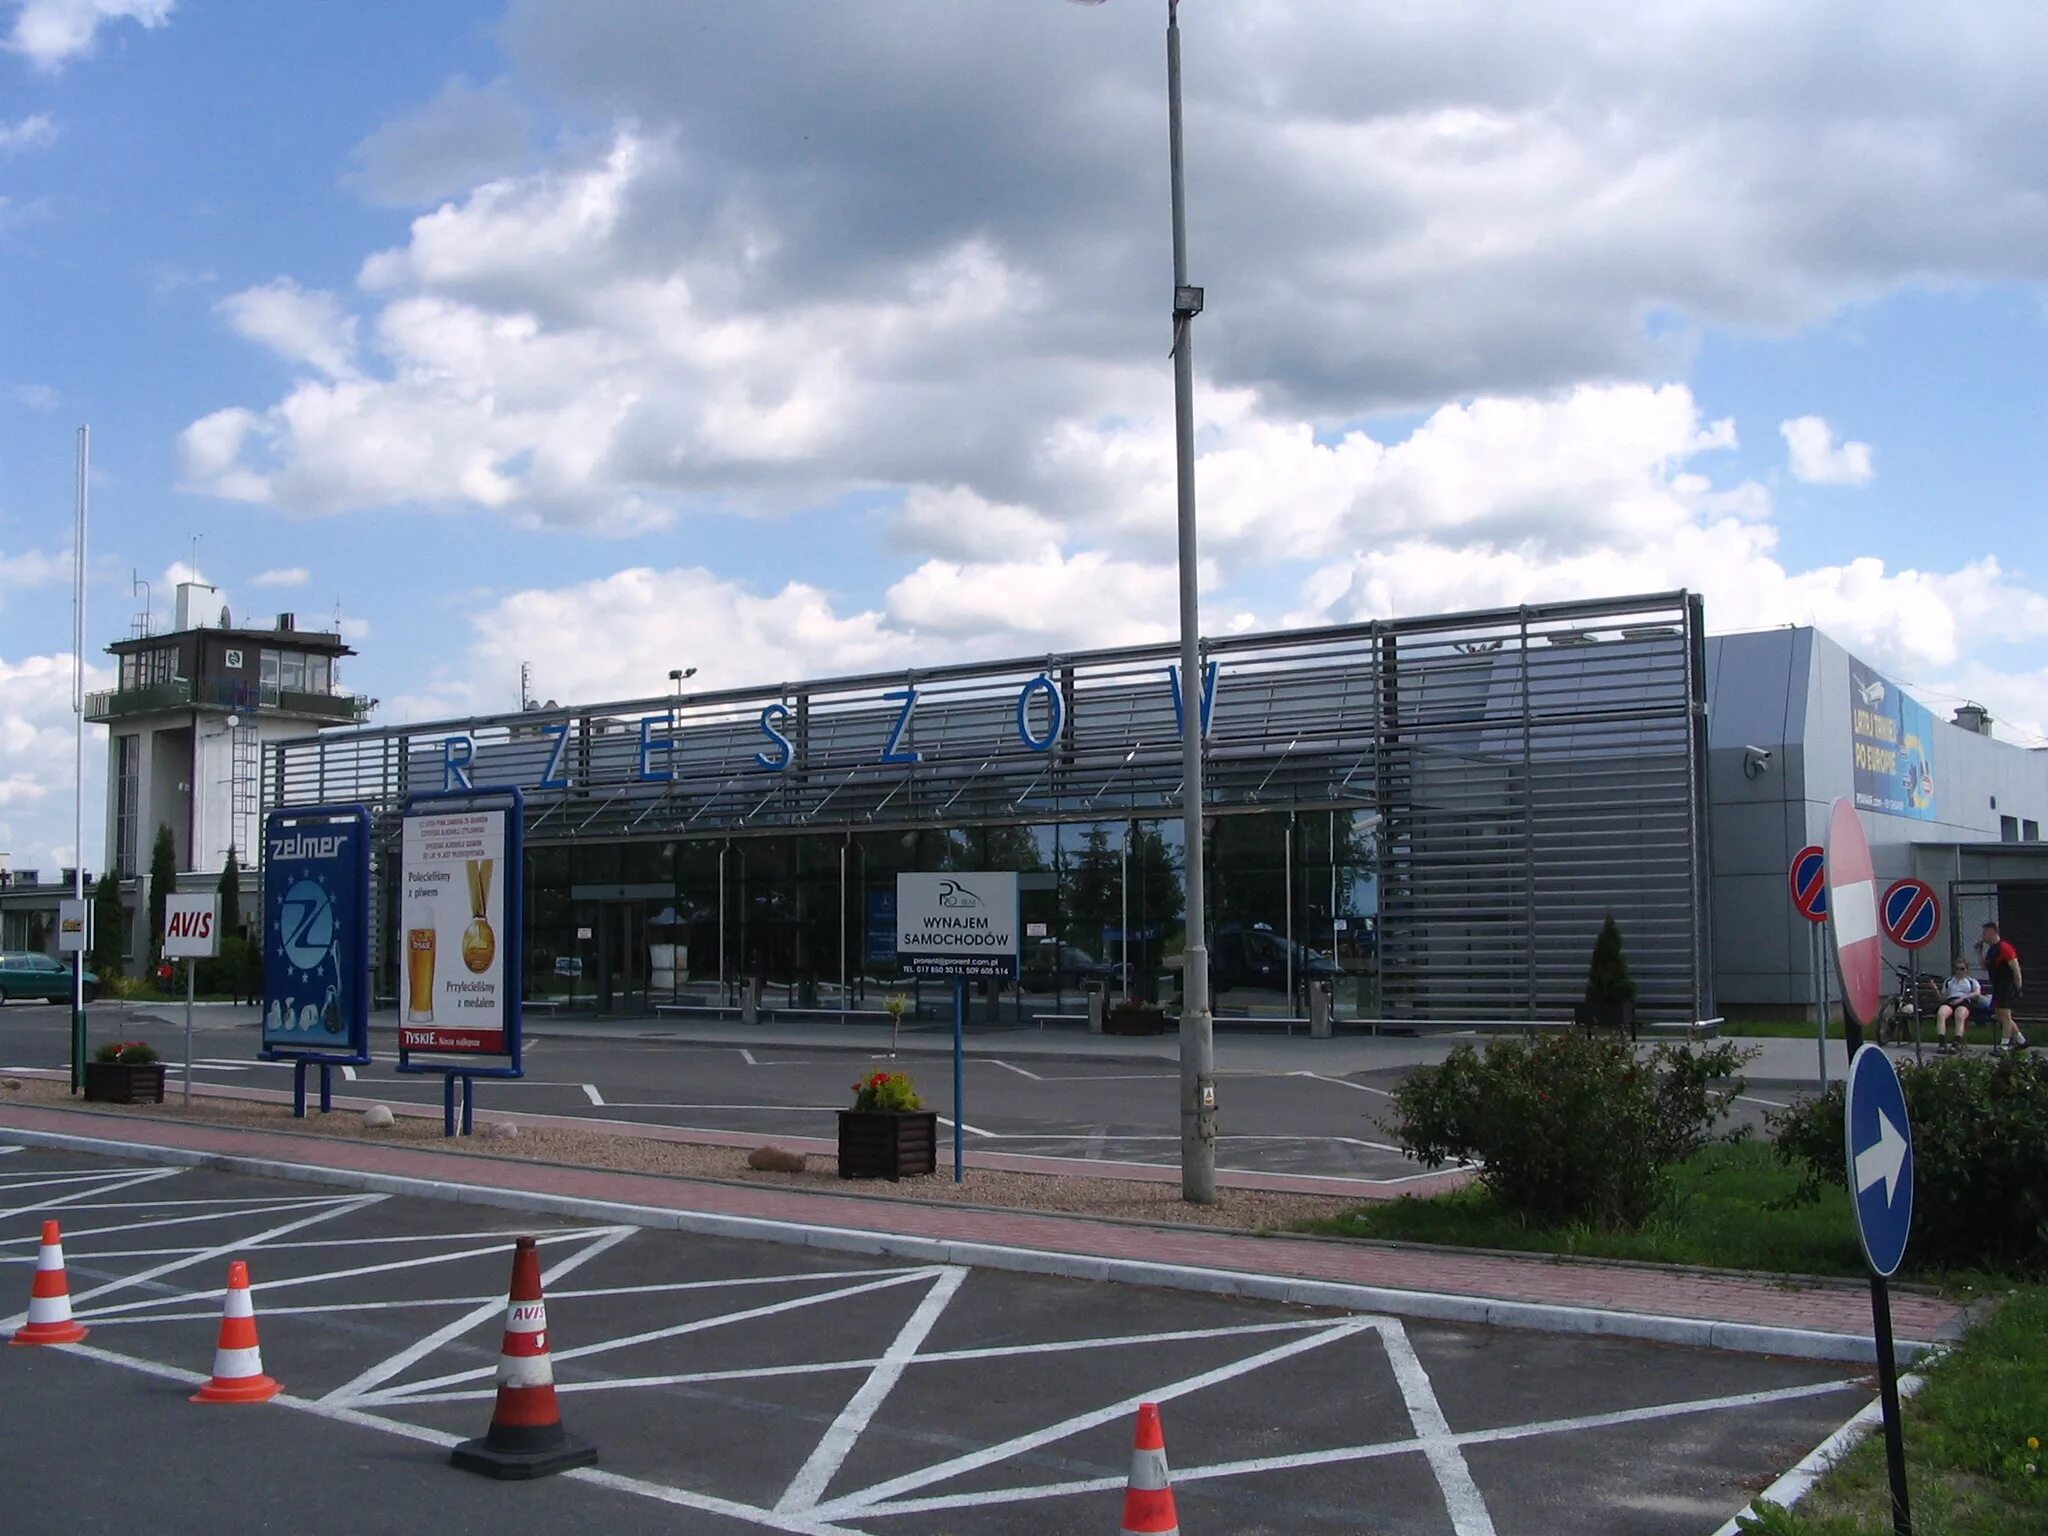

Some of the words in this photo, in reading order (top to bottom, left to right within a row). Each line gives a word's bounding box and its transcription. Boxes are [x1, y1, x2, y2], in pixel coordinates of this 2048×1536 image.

[443, 661, 1221, 792] RZESZÓW
[1855, 743, 1867, 769] PO
[269, 833, 348, 860] zelmer
[415, 889, 438, 899] piwem
[167, 912, 213, 938] AVIS
[923, 917, 989, 929] WYNAJEM
[904, 931, 1009, 946] SAMOCHODÓW
[903, 965, 915, 973] TEL.
[916, 965, 929, 973] 017
[463, 997, 495, 1008] medalem
[404, 1031, 437, 1045] TYSKIE.
[512, 1306, 545, 1321] AVIS
